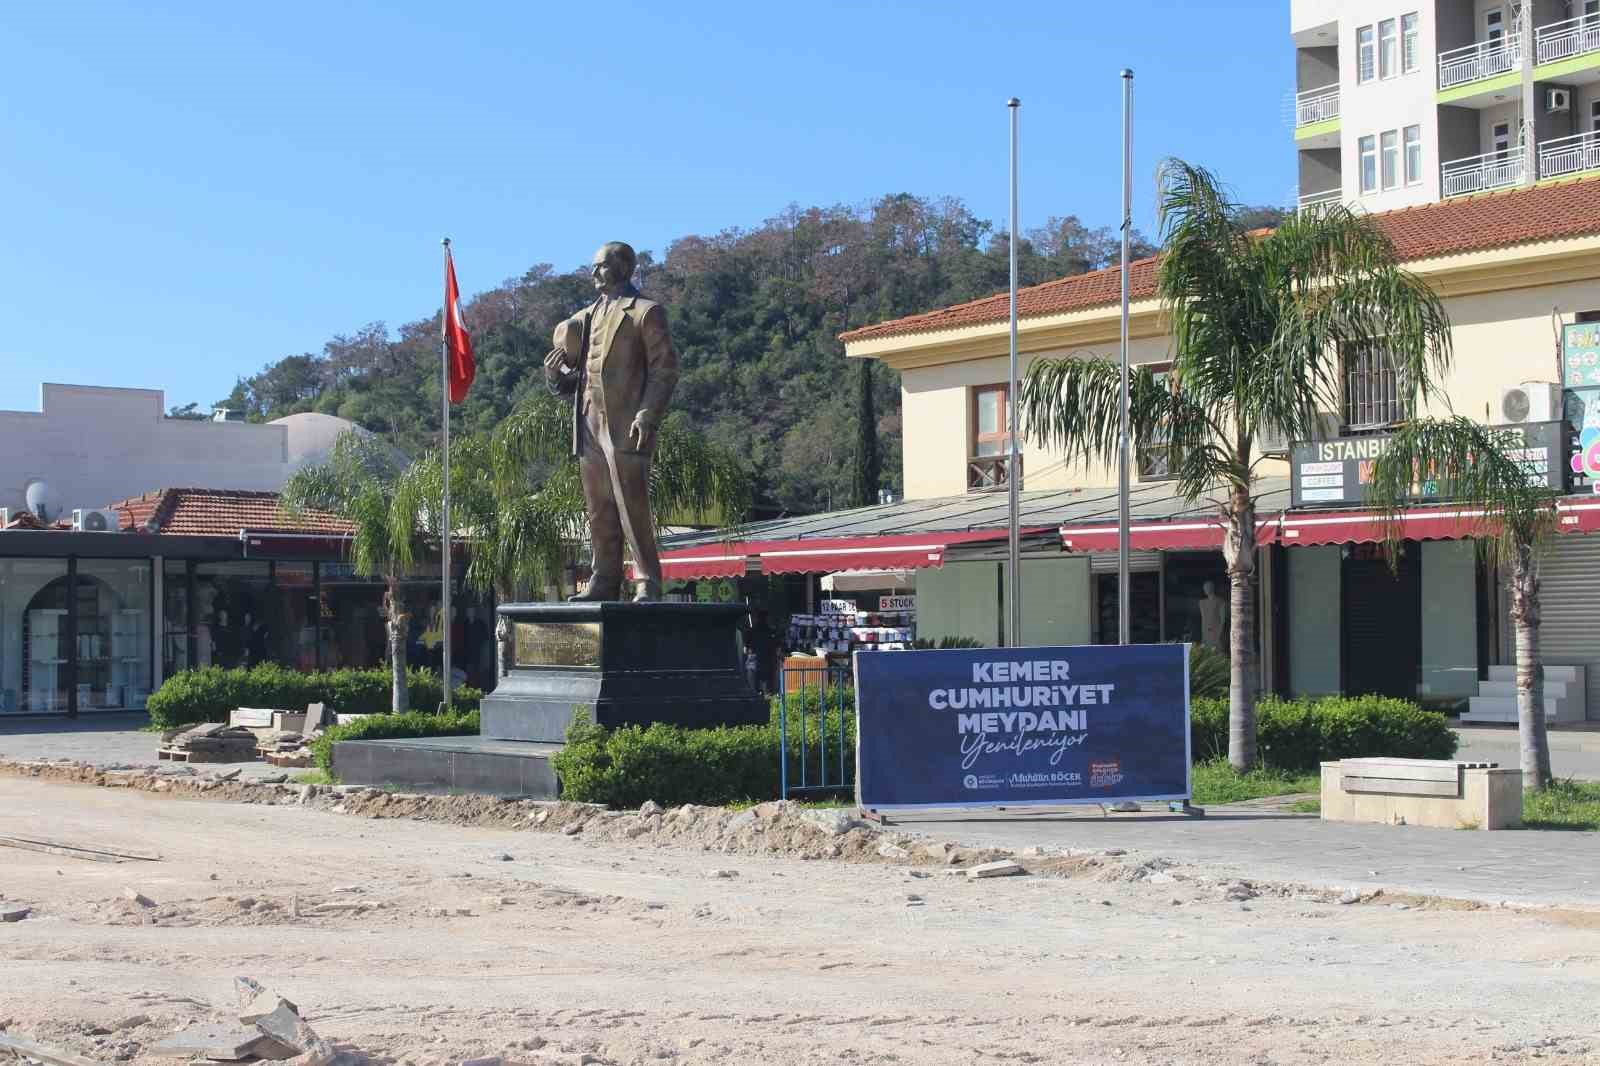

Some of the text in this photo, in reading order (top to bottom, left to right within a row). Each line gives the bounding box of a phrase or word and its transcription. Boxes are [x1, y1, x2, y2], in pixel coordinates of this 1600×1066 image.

[972, 660, 1070, 682] KEMER
[957, 710, 1088, 734] MEYDANI
[960, 728, 1088, 769] Yenileniyor
